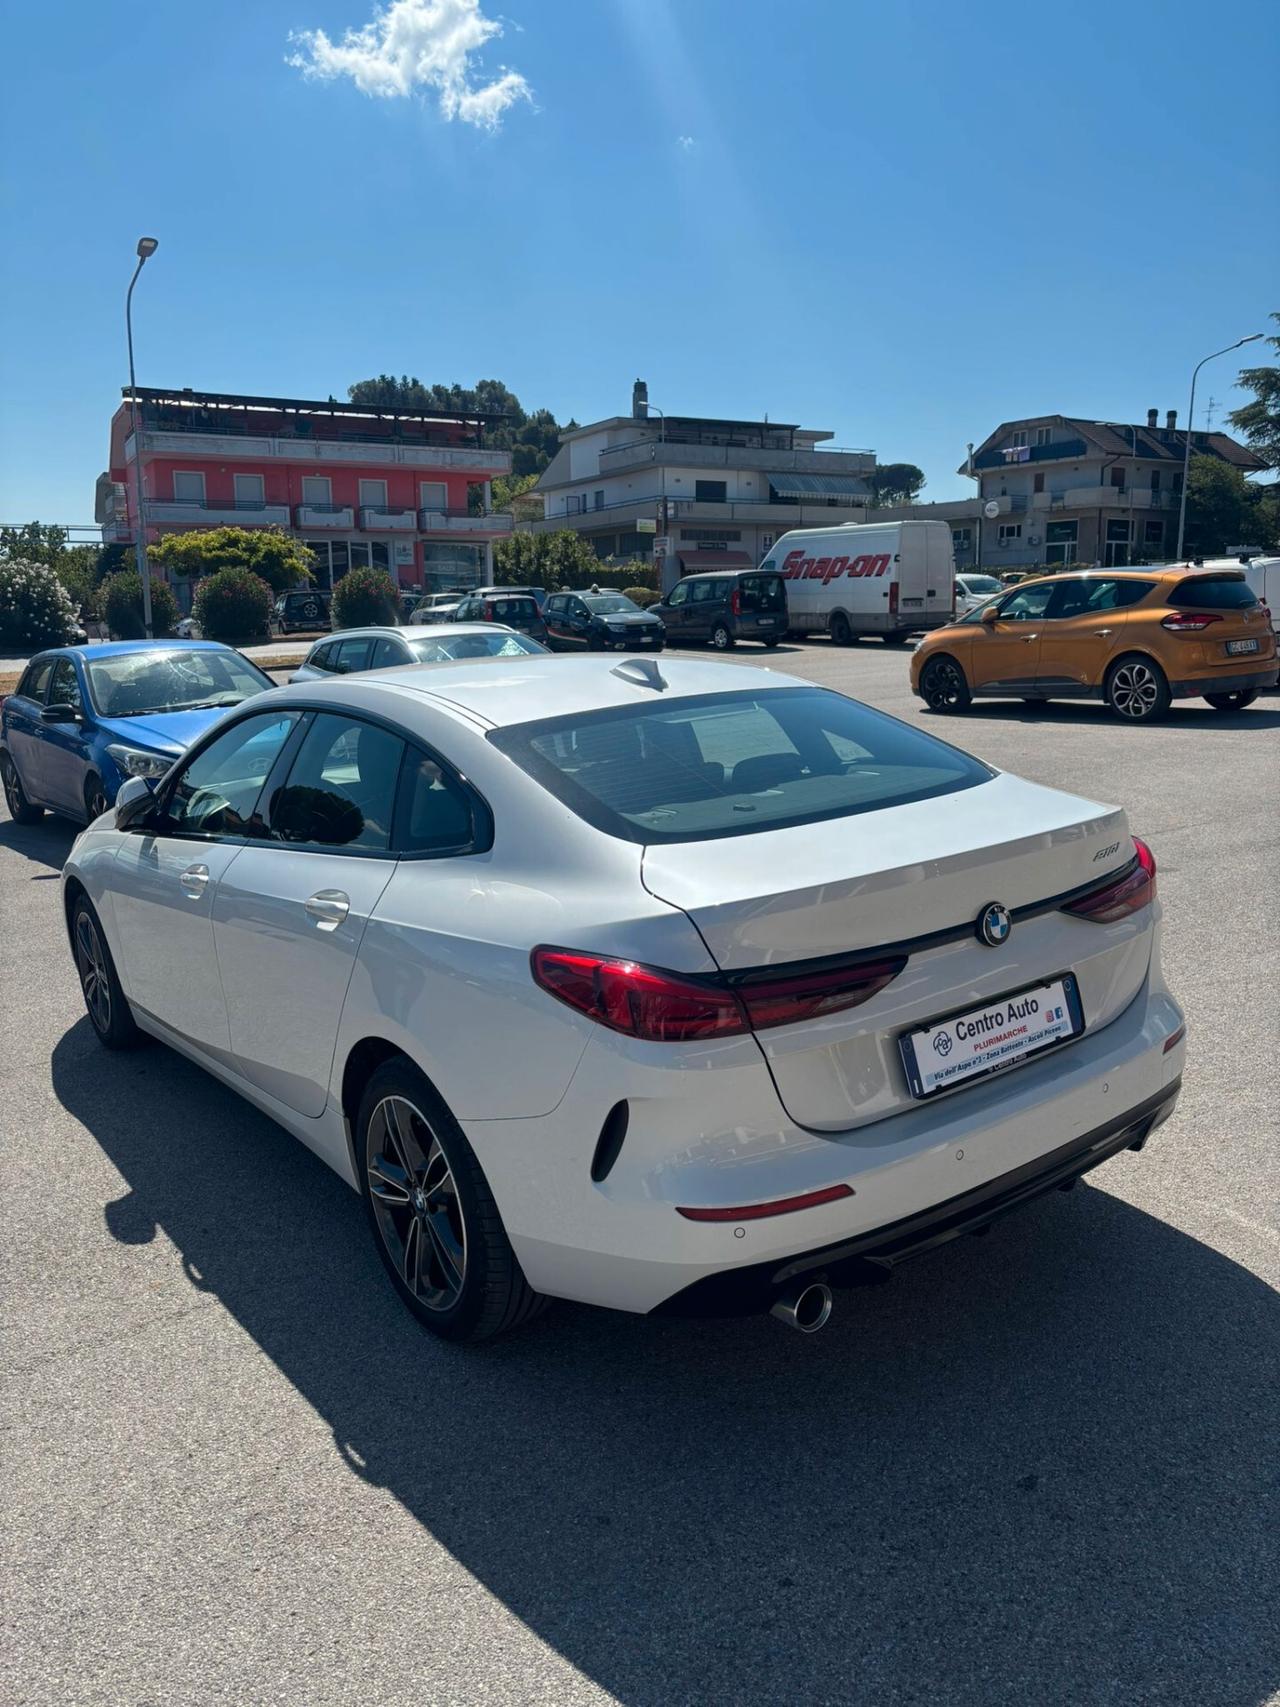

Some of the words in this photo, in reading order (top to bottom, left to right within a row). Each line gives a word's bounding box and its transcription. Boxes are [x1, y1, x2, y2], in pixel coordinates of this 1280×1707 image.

[782, 550, 891, 585] Snap-on
[956, 1011, 1004, 1041] Centro
[1008, 998, 1039, 1023] Auto
[973, 1025, 1028, 1052] PLURIMARCHE
[934, 1071, 944, 1081] Via
[986, 1051, 1000, 1060] Zona
[1028, 1031, 1043, 1043] Ascoli
